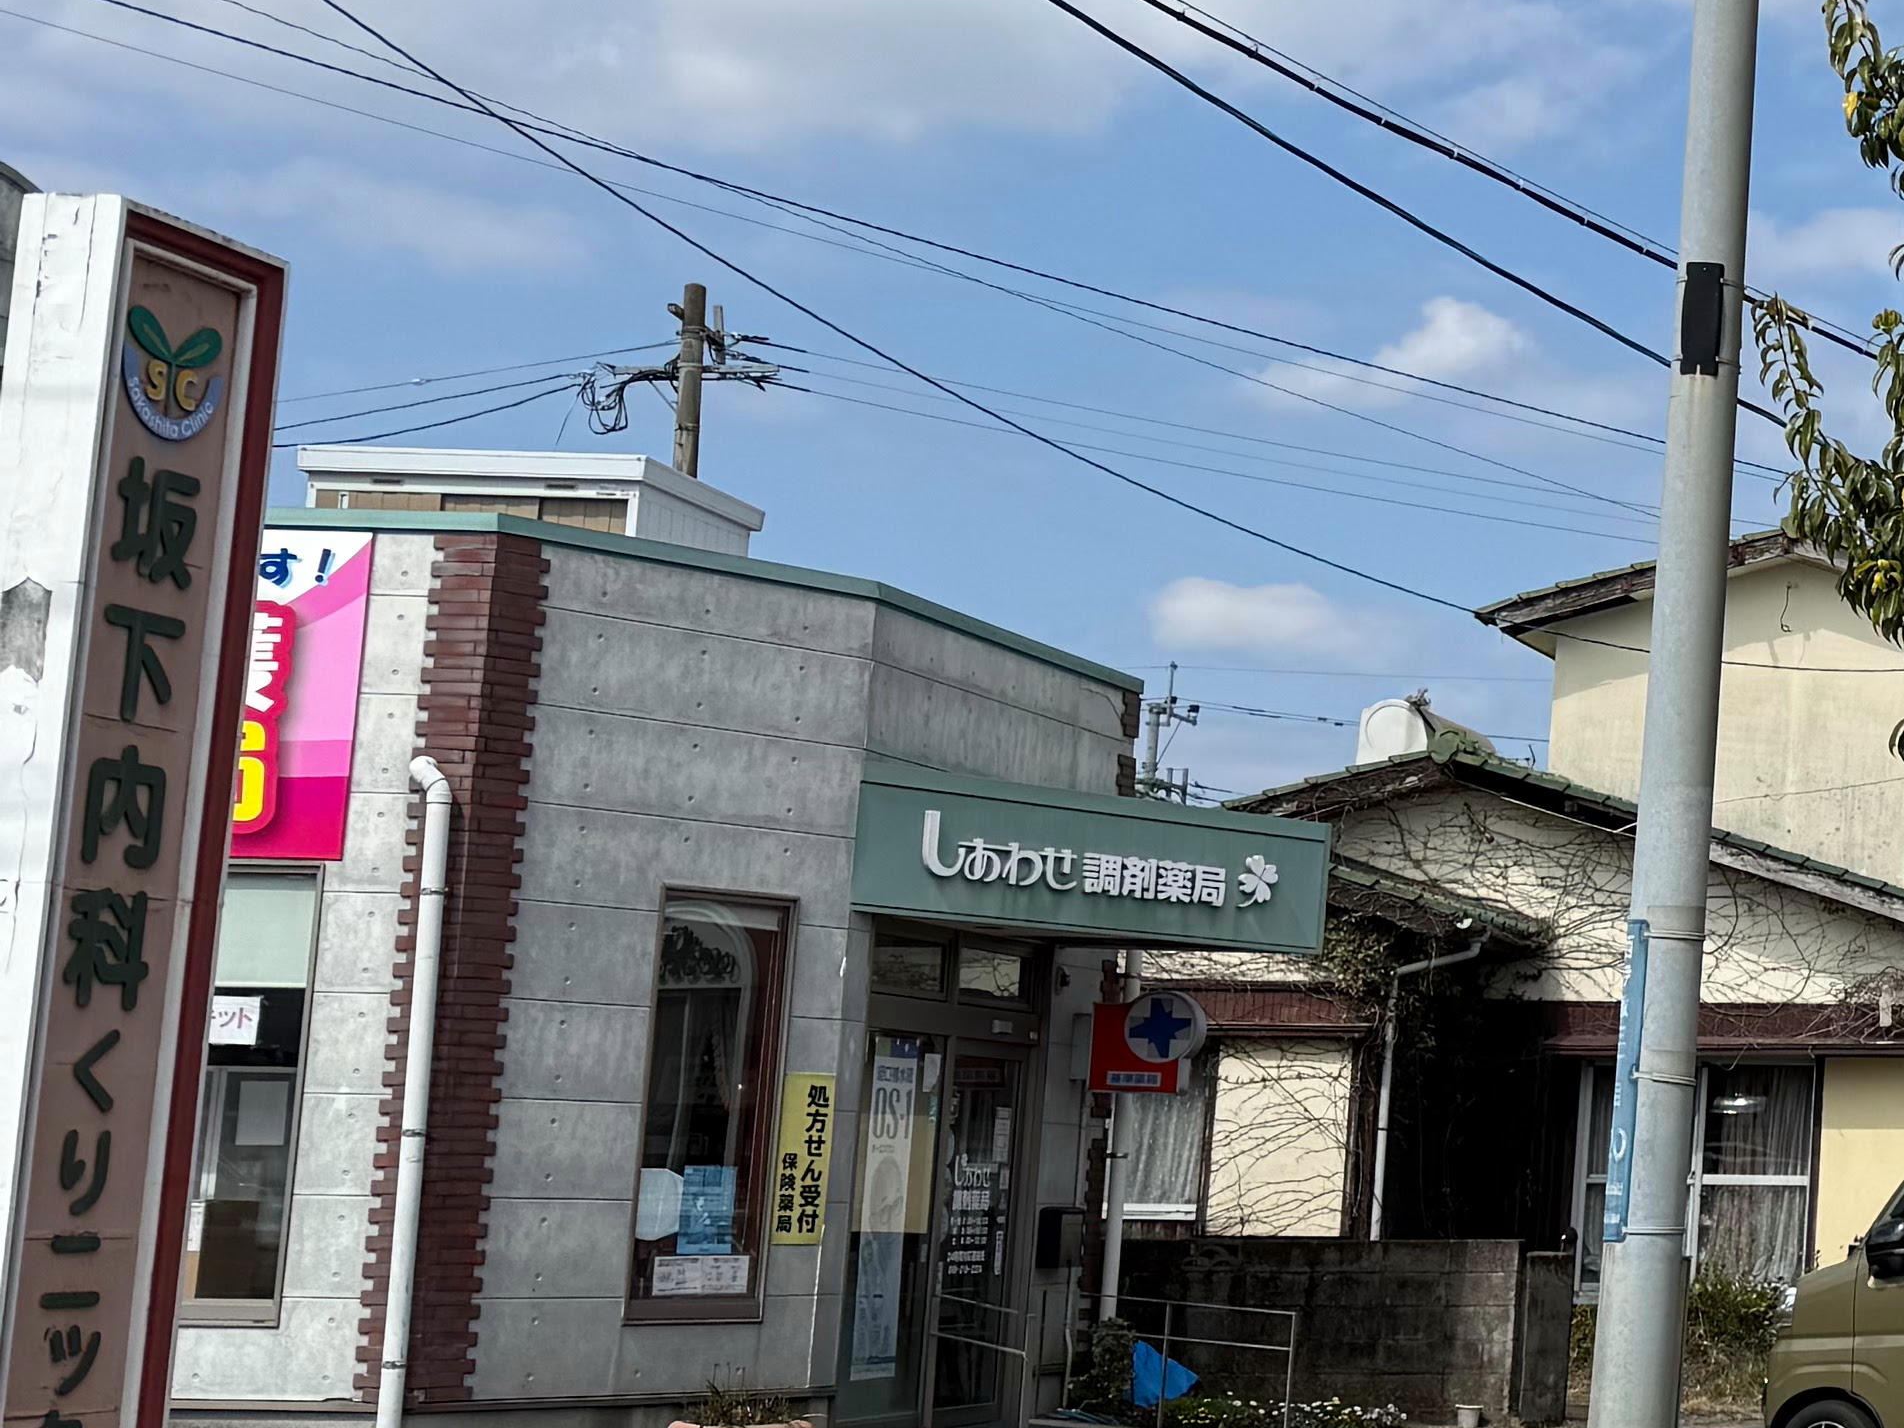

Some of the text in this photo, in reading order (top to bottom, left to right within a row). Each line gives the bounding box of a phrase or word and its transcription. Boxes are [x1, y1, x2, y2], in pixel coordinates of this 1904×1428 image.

[922, 810, 1226, 908] しあわせ調剤薬局
[210, 1006, 253, 1029] ット
[775, 1152, 798, 1234] 保険薬局
[796, 1084, 830, 1234] 処方せん受付
